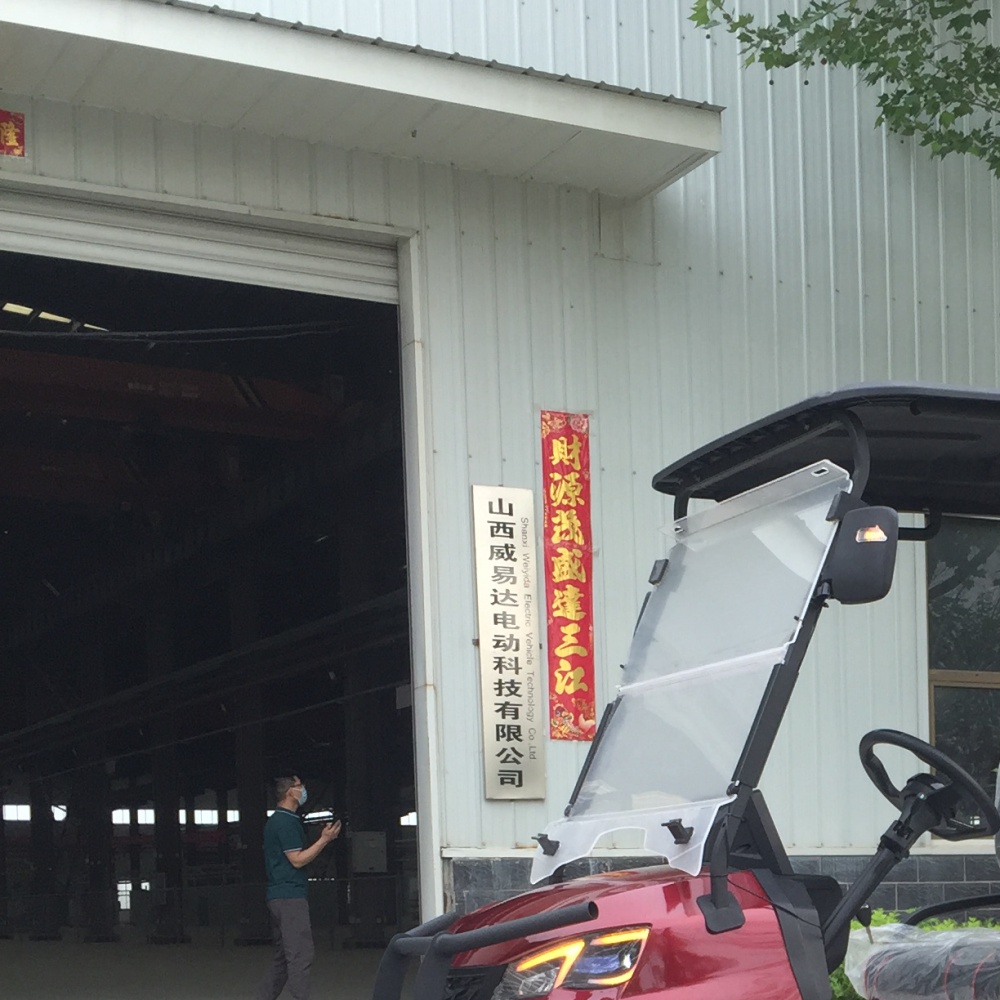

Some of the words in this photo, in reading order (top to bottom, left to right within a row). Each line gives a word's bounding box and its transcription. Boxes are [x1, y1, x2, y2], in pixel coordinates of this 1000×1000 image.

[520, 517, 529, 547] Shanxi
[521, 553, 531, 589] Weiyida
[523, 594, 532, 627] Electric
[487, 498, 524, 788] 山西威易达电动科技有限公司
[525, 632, 534, 665] Vehicle
[526, 671, 536, 723] Technology
